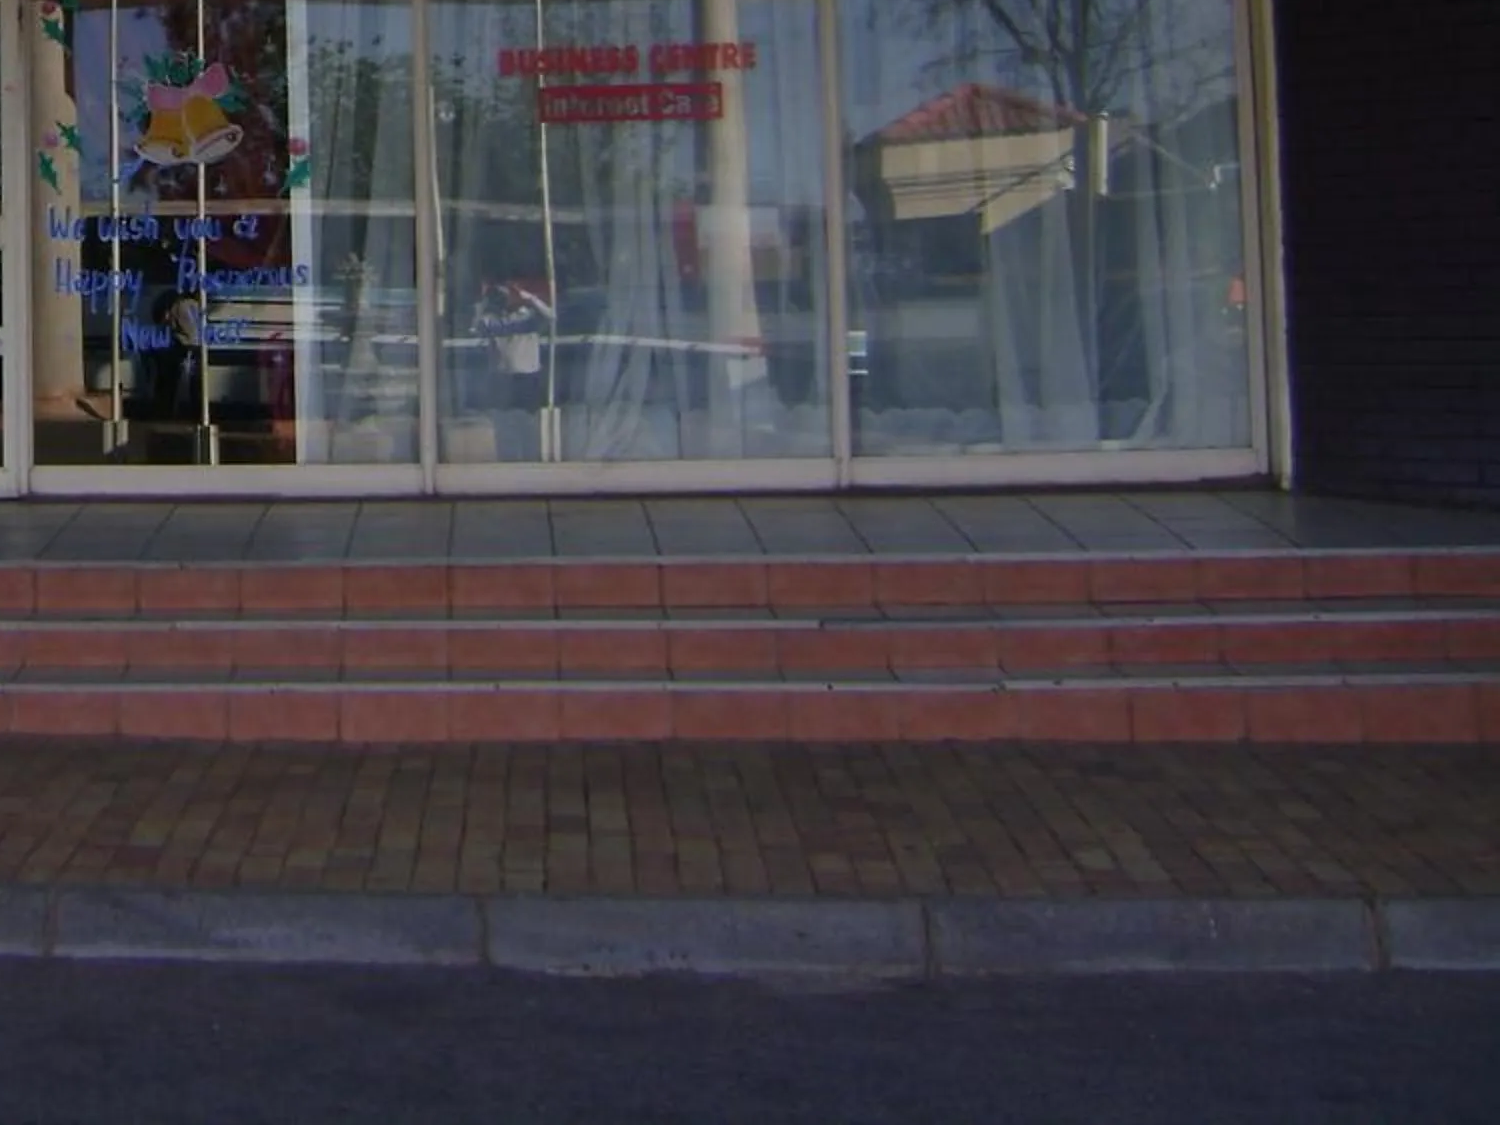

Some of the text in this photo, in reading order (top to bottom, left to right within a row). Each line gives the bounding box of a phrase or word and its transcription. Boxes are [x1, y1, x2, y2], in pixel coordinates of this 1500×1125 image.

[498, 42, 757, 76] BUSINESS CENTRE
[47, 203, 86, 241] We
[97, 203, 160, 241] wish
[172, 213, 222, 259] you
[54, 255, 144, 315] Happy
[120, 316, 174, 353] New
